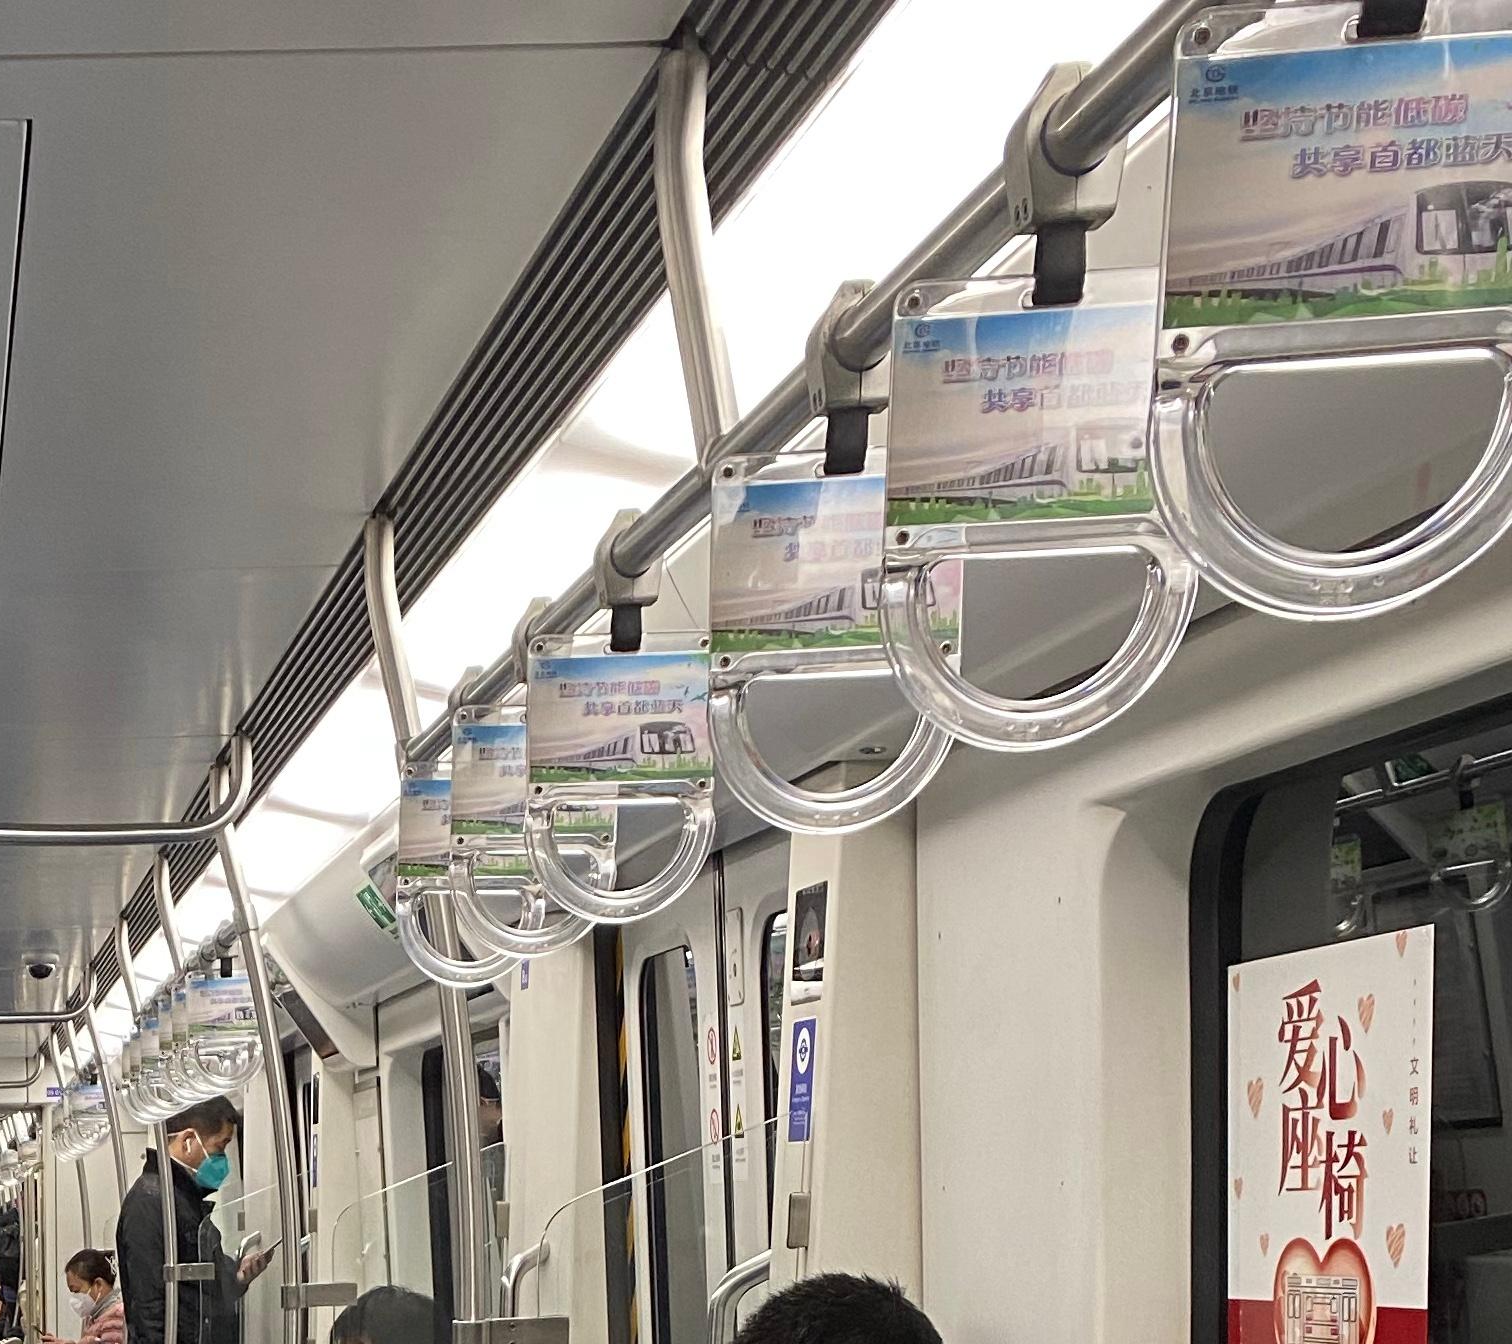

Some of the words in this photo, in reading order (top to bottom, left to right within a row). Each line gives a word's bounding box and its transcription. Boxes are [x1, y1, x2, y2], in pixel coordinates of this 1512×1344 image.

[1240, 94, 1469, 141] 坚持节能低碳
[1291, 132, 1512, 179] 共享首都蓝天
